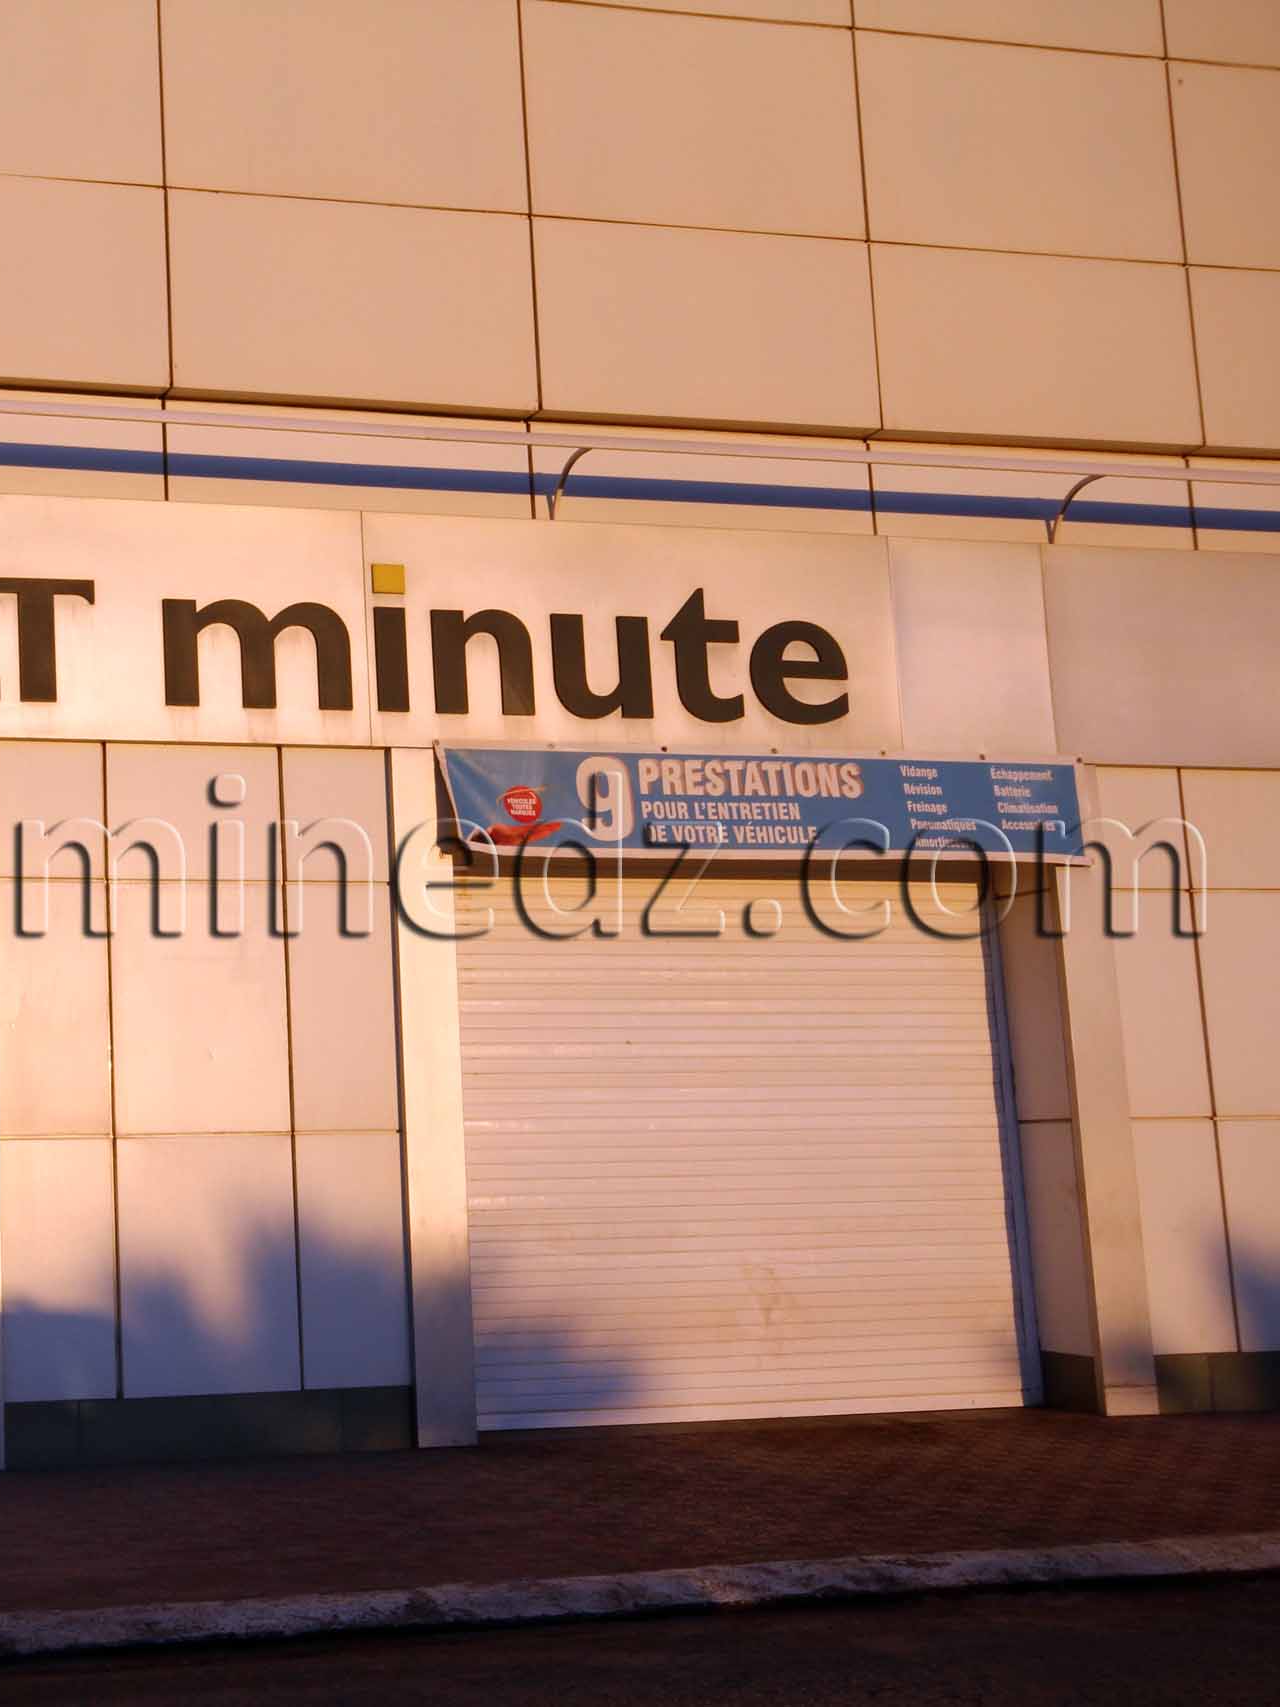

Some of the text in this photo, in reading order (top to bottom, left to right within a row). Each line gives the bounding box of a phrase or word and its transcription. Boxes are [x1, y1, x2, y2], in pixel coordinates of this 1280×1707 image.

[162, 562, 850, 726] minute
[638, 758, 865, 799] PRESTATIONS
[899, 765, 938, 779] Vidange
[576, 756, 635, 842] 9
[641, 801, 689, 819] POUR
[907, 800, 948, 815] Freinage
[672, 815, 729, 842] VOTRE
[1001, 818, 1056, 833] Accessores
